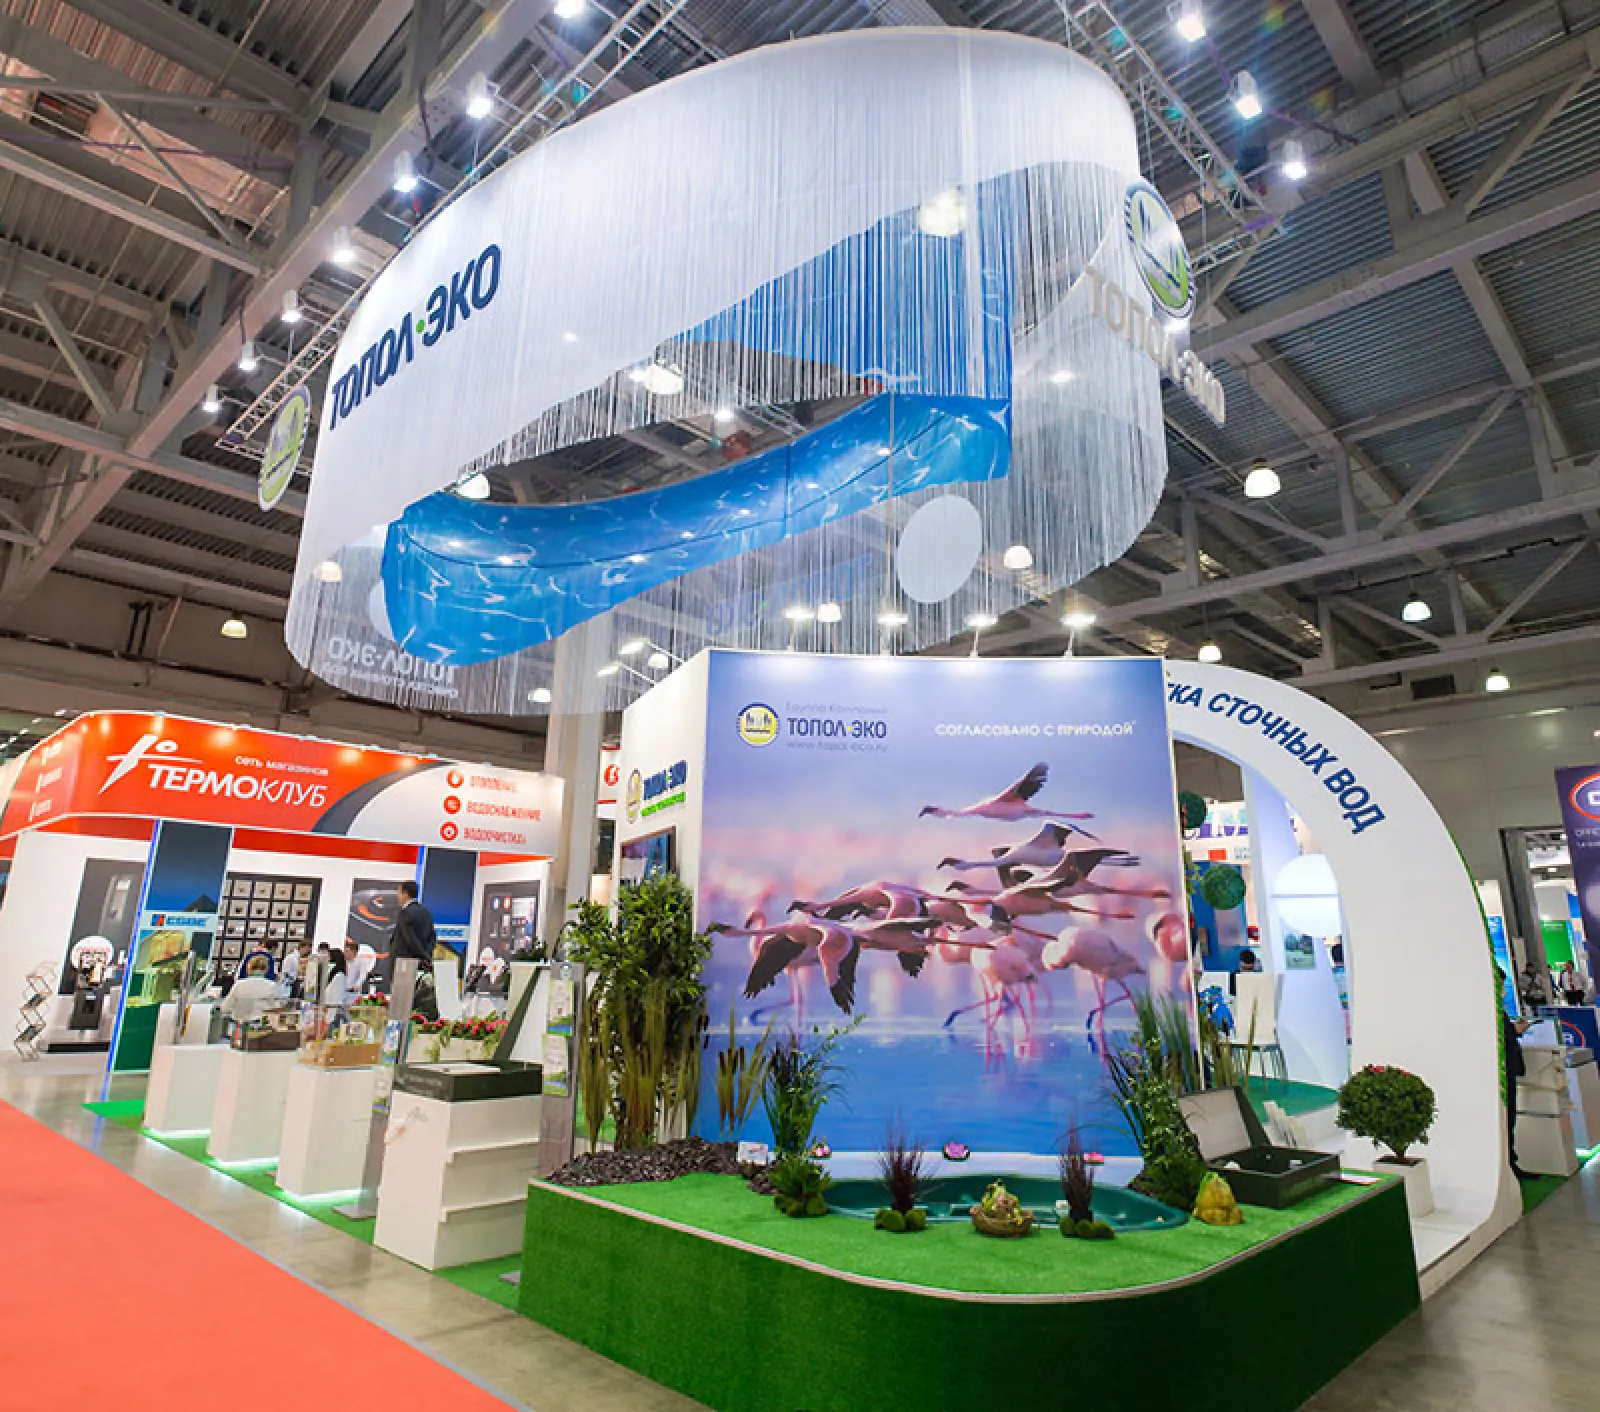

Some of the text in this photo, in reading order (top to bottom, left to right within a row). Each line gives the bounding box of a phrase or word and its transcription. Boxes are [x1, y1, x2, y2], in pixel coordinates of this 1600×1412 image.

[935, 721, 1133, 737] СОГЛАСОВАНО С ПРИРОДОЙ
[234, 755, 264, 768] сеть
[1167, 682, 1386, 834] КА СТОЧНЫХ ВОД
